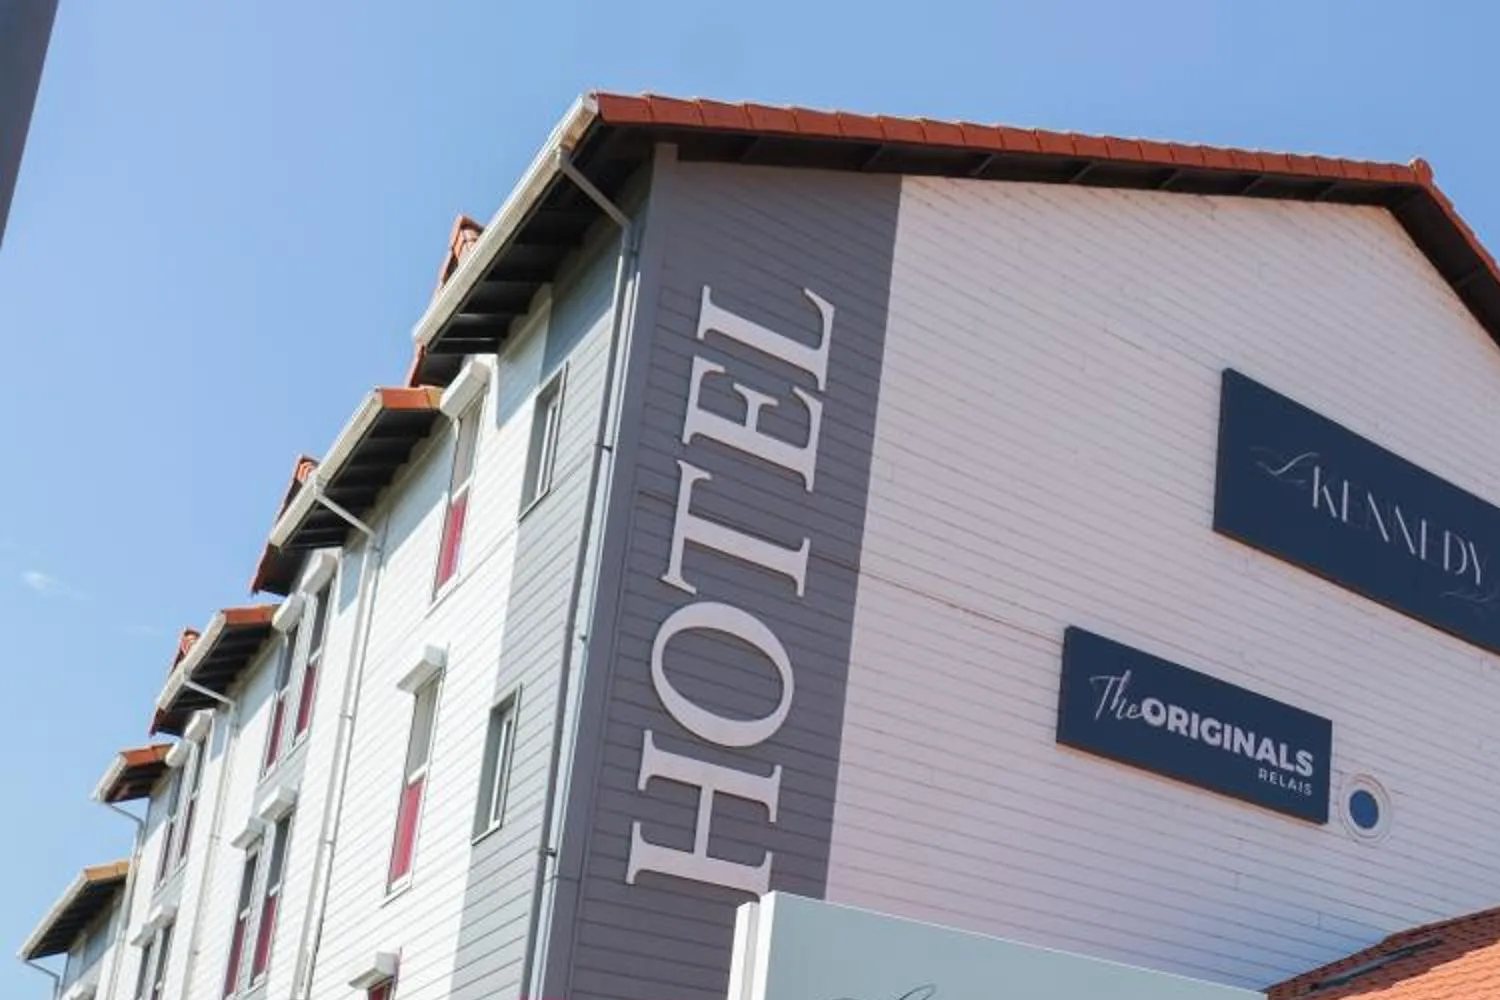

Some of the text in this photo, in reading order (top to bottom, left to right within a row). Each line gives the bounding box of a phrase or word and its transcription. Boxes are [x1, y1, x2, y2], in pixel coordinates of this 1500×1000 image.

[1311, 465, 1493, 586] KENNEDY
[625, 285, 835, 898] HOTEL
[1089, 669, 1314, 778] The ORIGINALS
[1258, 767, 1313, 797] RELAIS
